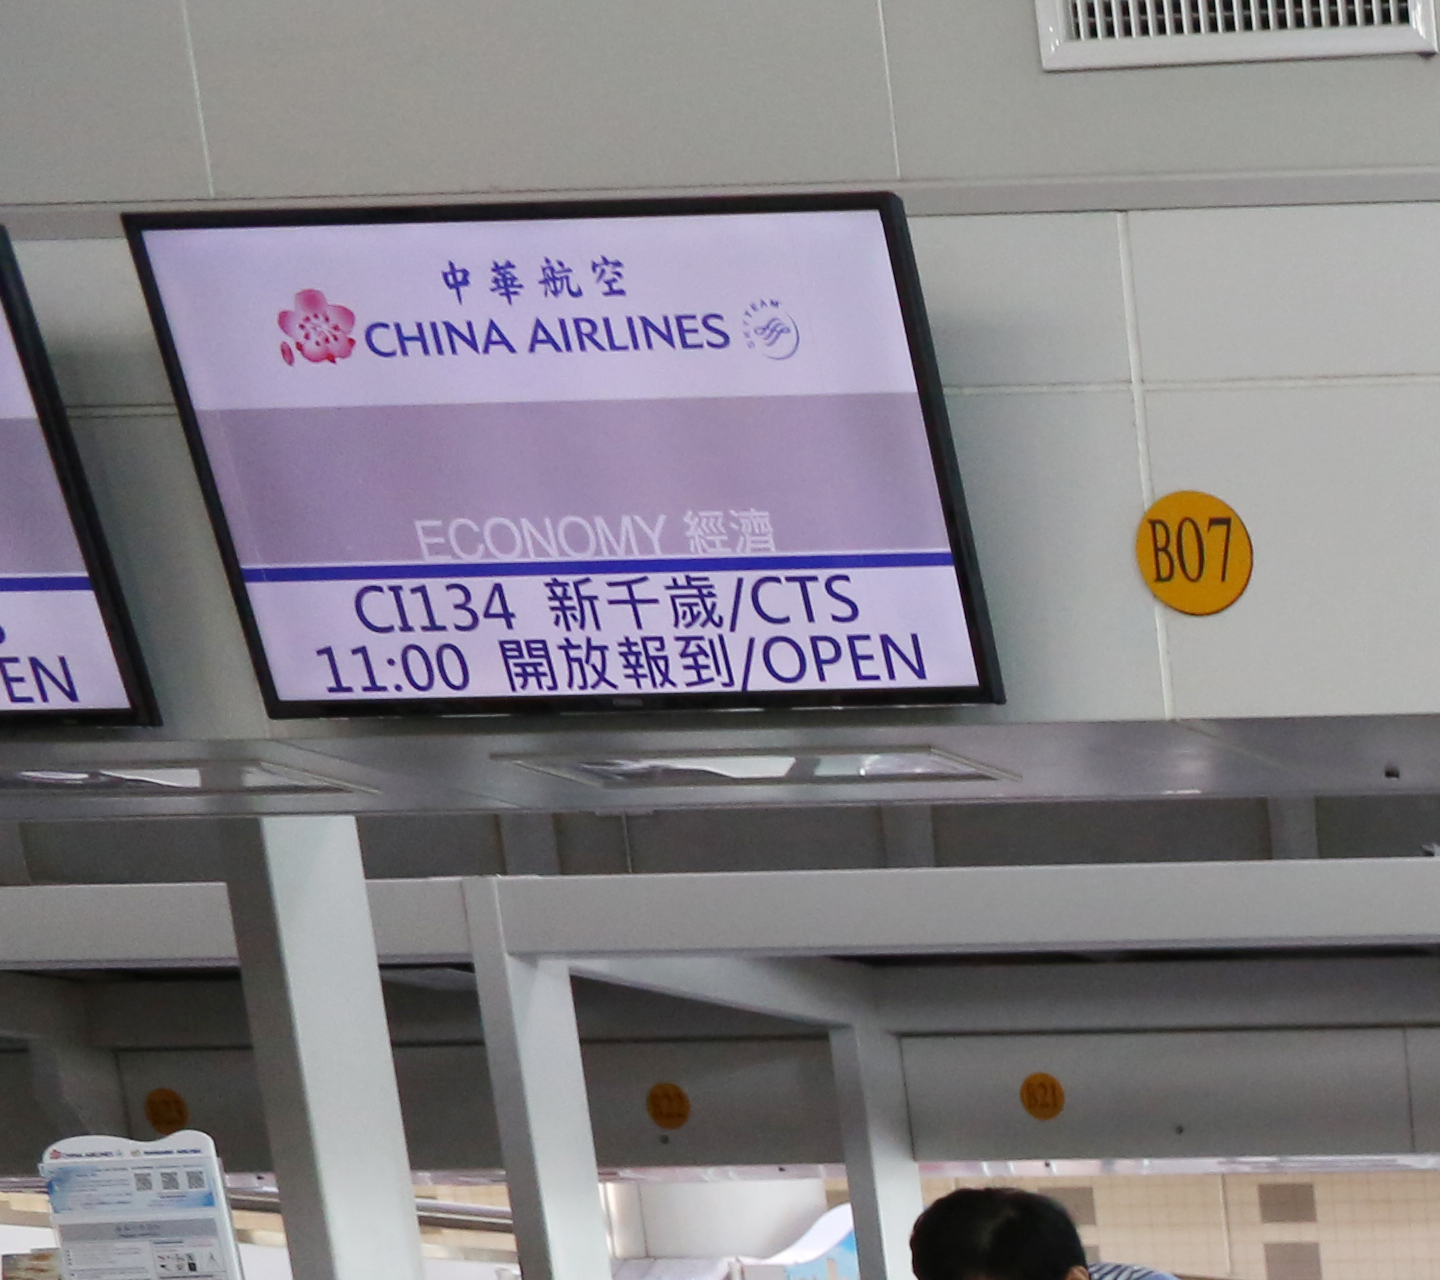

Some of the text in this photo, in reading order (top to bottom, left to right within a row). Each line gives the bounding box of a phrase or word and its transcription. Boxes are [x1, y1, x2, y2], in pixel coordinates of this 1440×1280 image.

[442, 255, 627, 304] 中華航空
[364, 313, 731, 358] CHINA AIRLINES
[414, 509, 777, 563] ECONOMY 經濟
[1147, 515, 1233, 584] B07
[354, 581, 517, 634] CI134
[317, 642, 471, 693] 11:00
